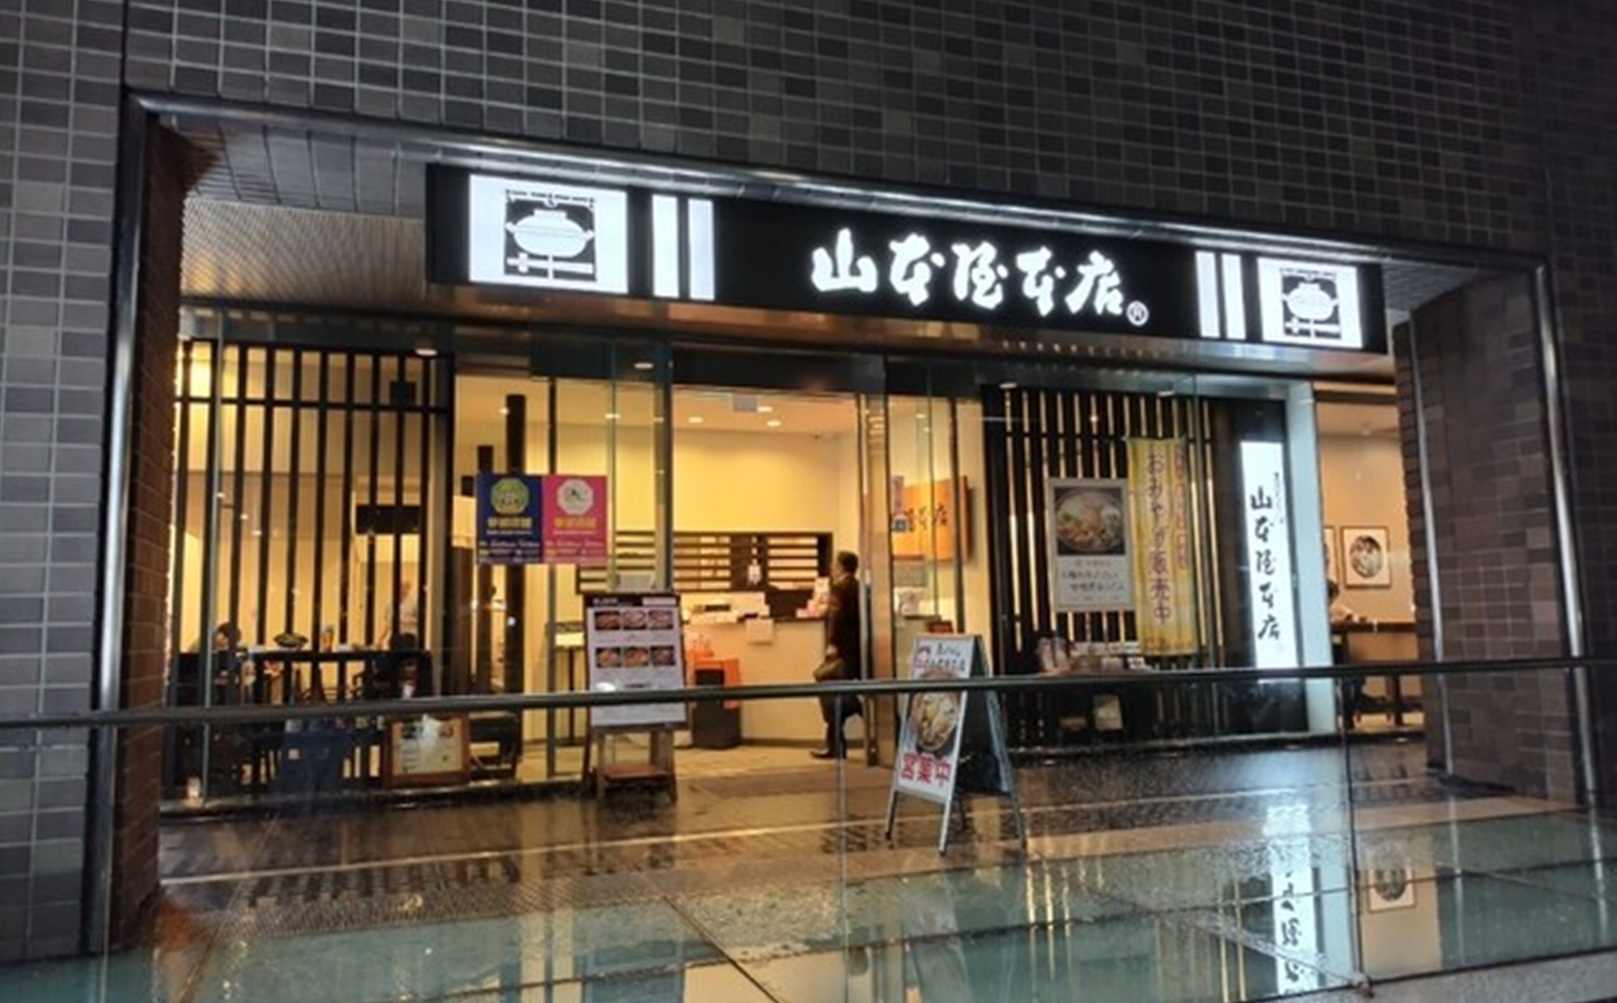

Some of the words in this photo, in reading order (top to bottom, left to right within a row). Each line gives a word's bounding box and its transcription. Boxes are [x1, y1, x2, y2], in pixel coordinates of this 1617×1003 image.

[810, 228, 1123, 317] 山本屋本店
[1250, 485, 1281, 641] 山本屋本店
[901, 752, 951, 788] 営業中
